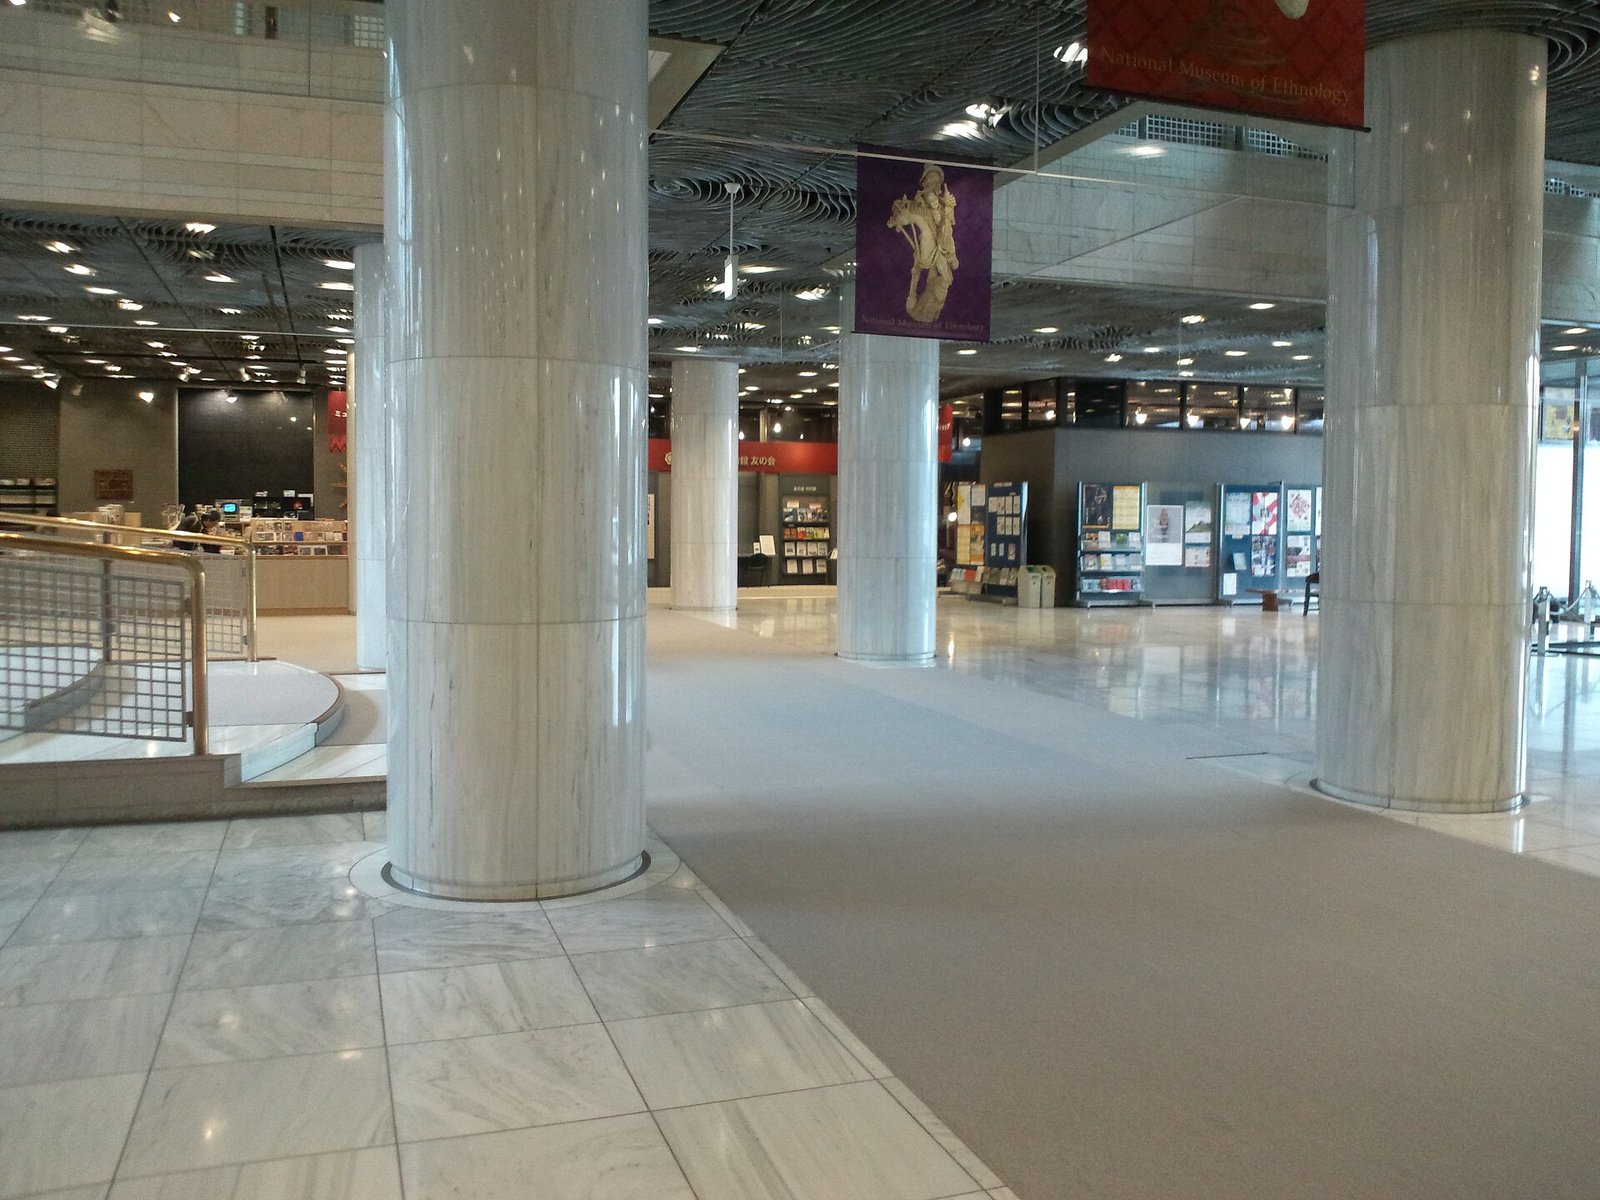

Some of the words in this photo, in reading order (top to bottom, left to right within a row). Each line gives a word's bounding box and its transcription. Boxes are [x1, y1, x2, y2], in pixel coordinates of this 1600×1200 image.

[1101, 47, 1173, 73] National
[1179, 60, 1247, 87] Museum
[1250, 75, 1267, 91] of
[1273, 76, 1352, 106] Ethnology
